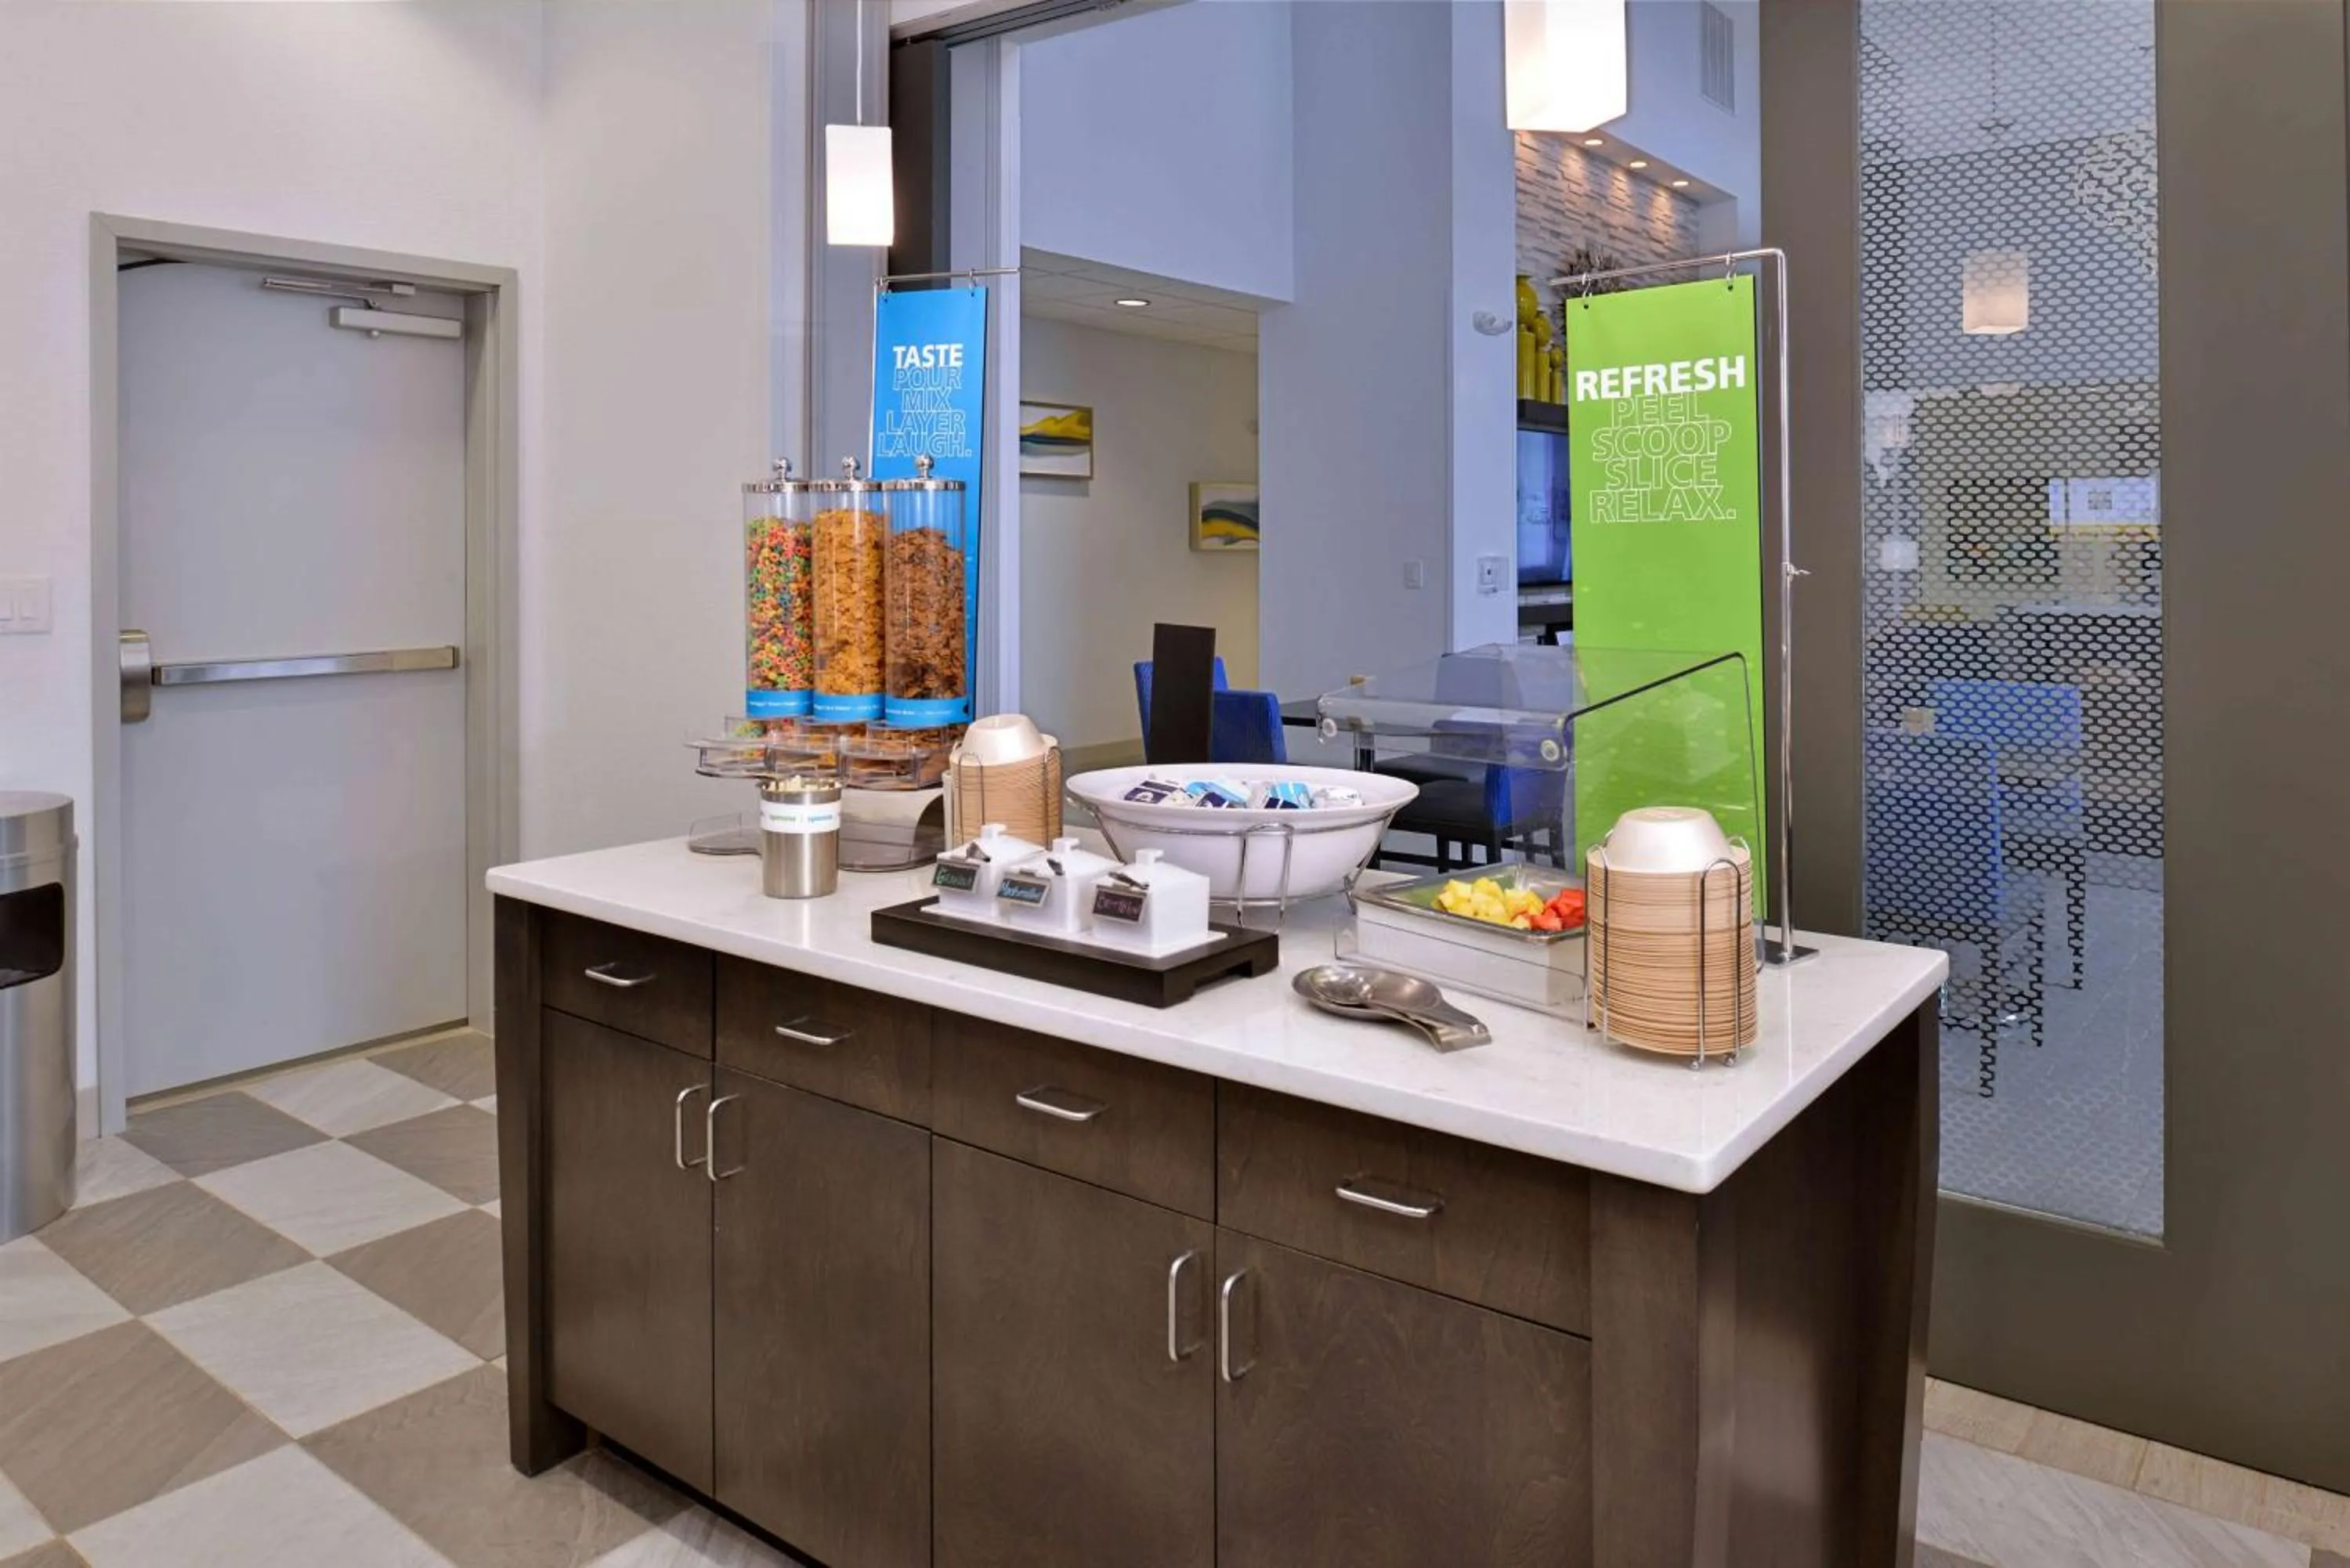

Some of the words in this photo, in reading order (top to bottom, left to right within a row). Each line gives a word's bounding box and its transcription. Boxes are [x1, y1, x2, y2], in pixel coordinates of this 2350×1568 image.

[893, 344, 964, 368] TASTE
[893, 367, 962, 390] POUR
[1576, 355, 1745, 402] REFRESH
[902, 388, 952, 412] MIX
[1611, 392, 1709, 428] PEEL
[886, 410, 966, 435] LAYER
[877, 432, 972, 457] LAUGH.
[1591, 420, 1732, 461] SCOOP
[1606, 454, 1718, 491] SLICE
[1589, 485, 1737, 524] RELAX.
